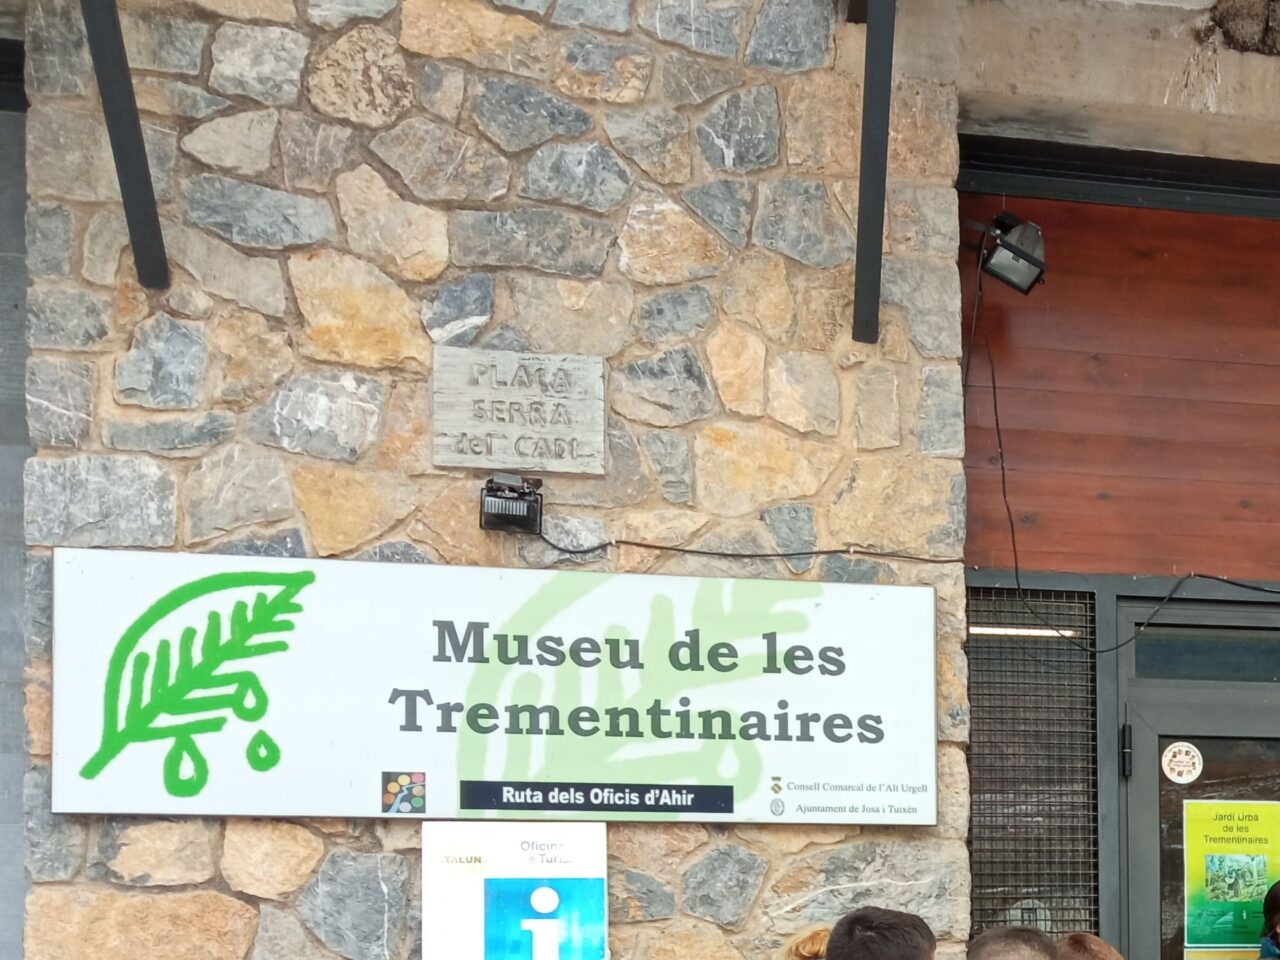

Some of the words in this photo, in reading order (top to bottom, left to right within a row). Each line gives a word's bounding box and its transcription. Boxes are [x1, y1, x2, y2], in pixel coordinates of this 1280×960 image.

[468, 361, 573, 393] PLAÇA
[472, 399, 572, 427] SERRA
[454, 431, 494, 456] del
[433, 619, 644, 669] Museu
[668, 629, 739, 673] de
[762, 631, 847, 677] les
[388, 687, 885, 745] Trementinaires
[502, 786, 543, 804] Ruta
[548, 787, 585, 805] dels
[590, 788, 640, 806] Oficis
[644, 788, 695, 807] d'Ahir
[786, 782, 820, 792] Consell
[822, 783, 864, 793] Comarcal
[866, 783, 877, 792] de
[901, 784, 928, 795] Urgell
[795, 804, 846, 815] Ajuntament
[848, 804, 859, 814] de
[861, 804, 880, 814] Josa
[888, 804, 918, 814] Tuixén
[1204, 835, 1269, 844] Trementinaires
[1222, 825, 1234, 833] de
[1236, 825, 1250, 833] les
